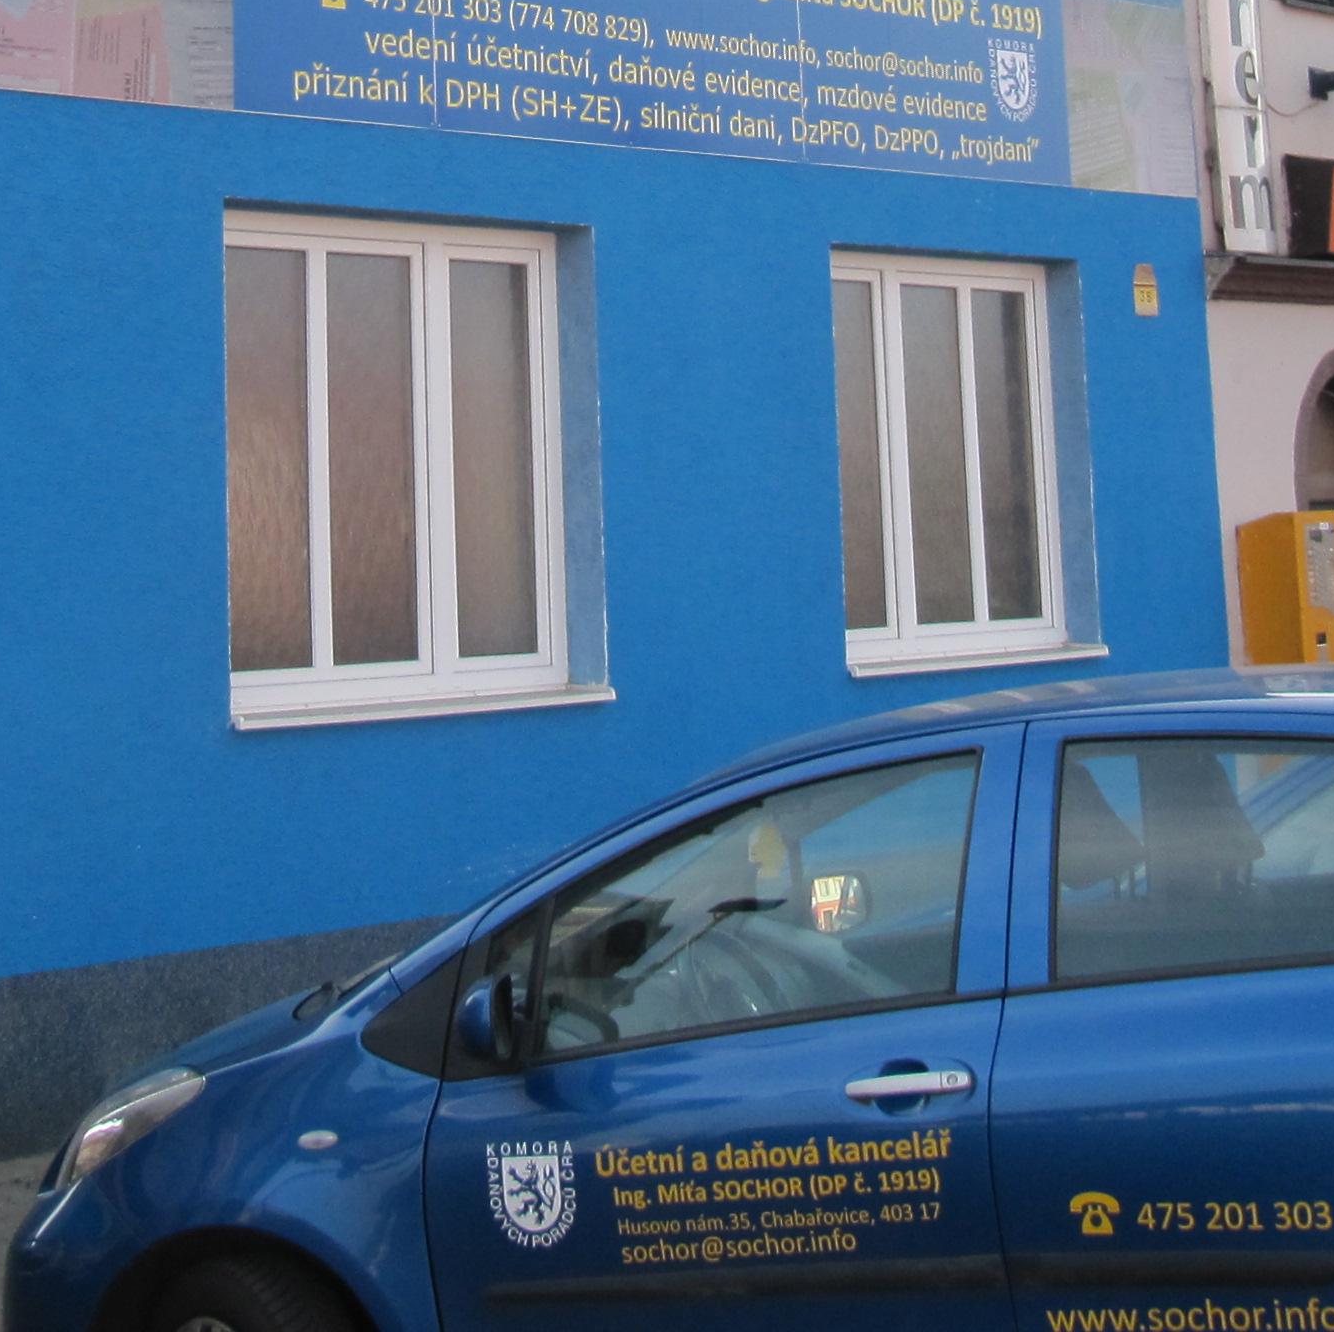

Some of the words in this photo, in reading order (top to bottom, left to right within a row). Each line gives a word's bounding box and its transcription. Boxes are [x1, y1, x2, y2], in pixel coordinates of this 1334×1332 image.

[990, 3, 1042, 40] 1919)
[509, 0, 555, 32] (774
[561, 8, 599, 38] 708
[604, 15, 655, 49] 829),
[665, 29, 820, 69] www.sochor.info,
[825, 45, 983, 84] sochor@sochor.info
[987, 38, 1035, 53] KOMORA
[364, 29, 457, 63] vedení
[467, 33, 599, 85] účetnictví,
[609, 55, 696, 91] daňové
[704, 69, 809, 108] evidence,
[817, 84, 897, 113] mzdové
[903, 91, 987, 122] evidence
[294, 62, 408, 101] přiznání
[419, 74, 434, 106] k
[445, 78, 500, 111] DPH
[511, 84, 630, 132] (SH+ZE),
[640, 101, 721, 135] silniční
[729, 110, 782, 146] dani,
[791, 116, 866, 154] DzPFO,
[874, 124, 944, 160] DzPPO,
[486, 1140, 573, 1157] KOMORA
[595, 1143, 684, 1178] Účetní
[691, 1150, 708, 1172] a
[716, 1136, 819, 1171] daňová
[827, 1127, 952, 1165] kancelář
[613, 1186, 652, 1210] Ing.
[657, 1180, 707, 1204] Míťa
[712, 1176, 804, 1202] SOCHOR
[809, 1173, 848, 1201] (DP
[853, 1171, 872, 1194] č.
[878, 1166, 940, 1194] 1919)
[618, 1217, 681, 1235] Husovo
[685, 1212, 758, 1232] nám.35,
[760, 1206, 876, 1230] Chabařovice,
[880, 1203, 914, 1222] 403
[919, 1201, 941, 1220] 17
[1137, 1202, 1195, 1231] 475
[1204, 1201, 1264, 1231] 201
[1273, 1200, 1334, 1231] 303
[621, 1227, 857, 1263] sochor@sochor.info
